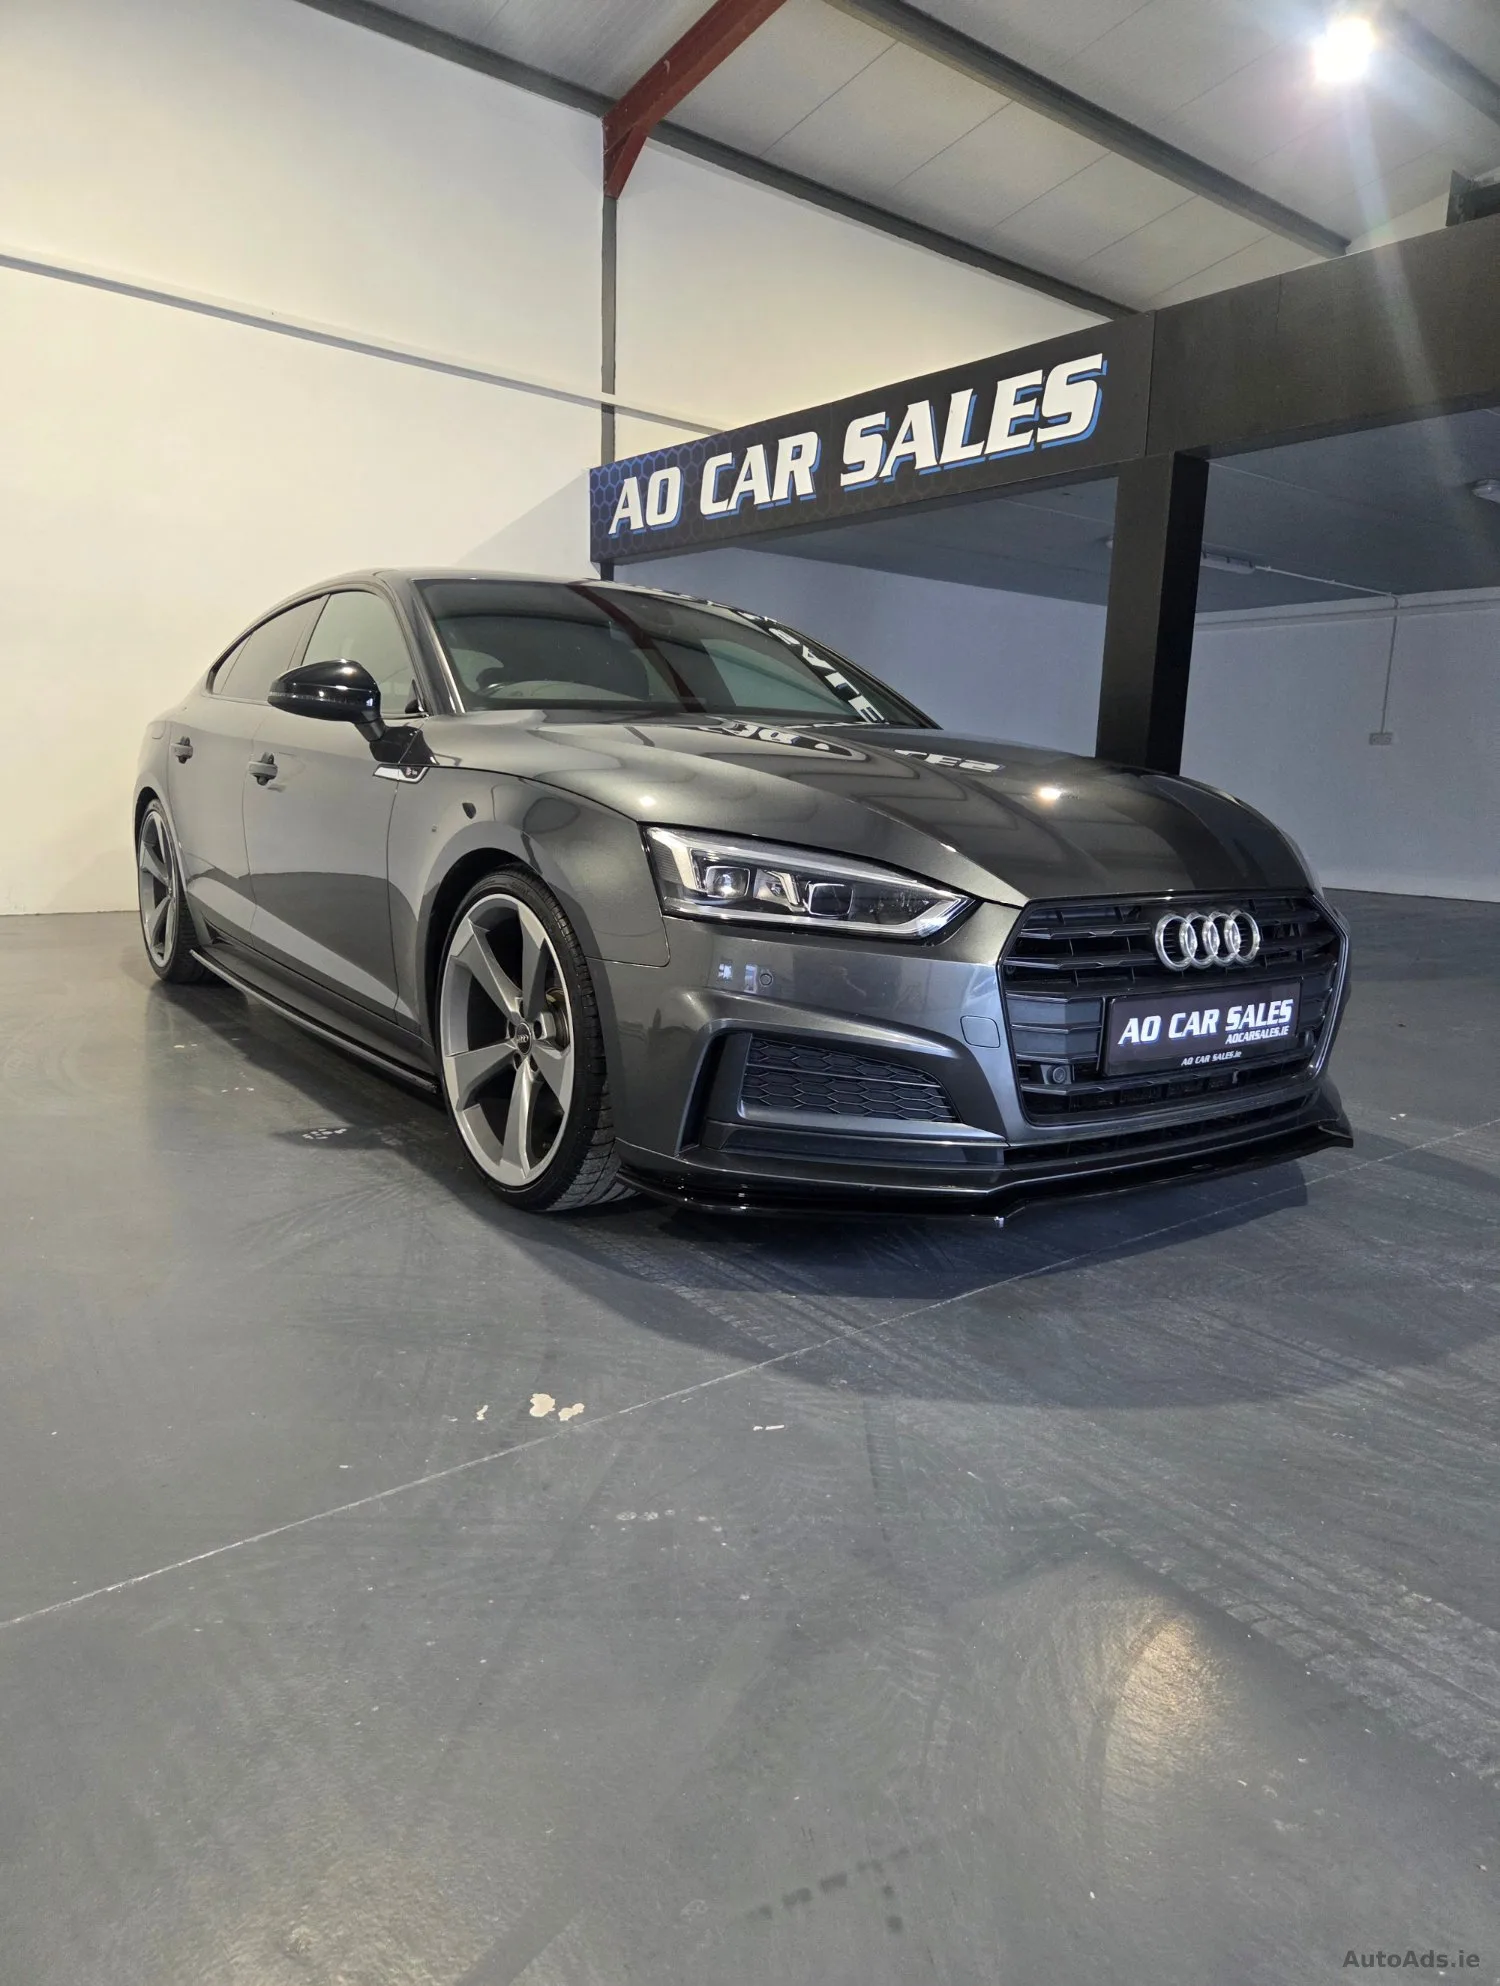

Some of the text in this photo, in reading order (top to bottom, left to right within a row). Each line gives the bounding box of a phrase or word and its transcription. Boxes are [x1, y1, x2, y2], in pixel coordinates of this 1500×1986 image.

[607, 353, 1106, 538] AO CAR SALES
[1117, 999, 1294, 1045] AO CAR SALES
[1224, 1025, 1290, 1045] AOCARSALES.IE
[1181, 1056, 1193, 1066] AO
[1195, 1054, 1210, 1064] CAR
